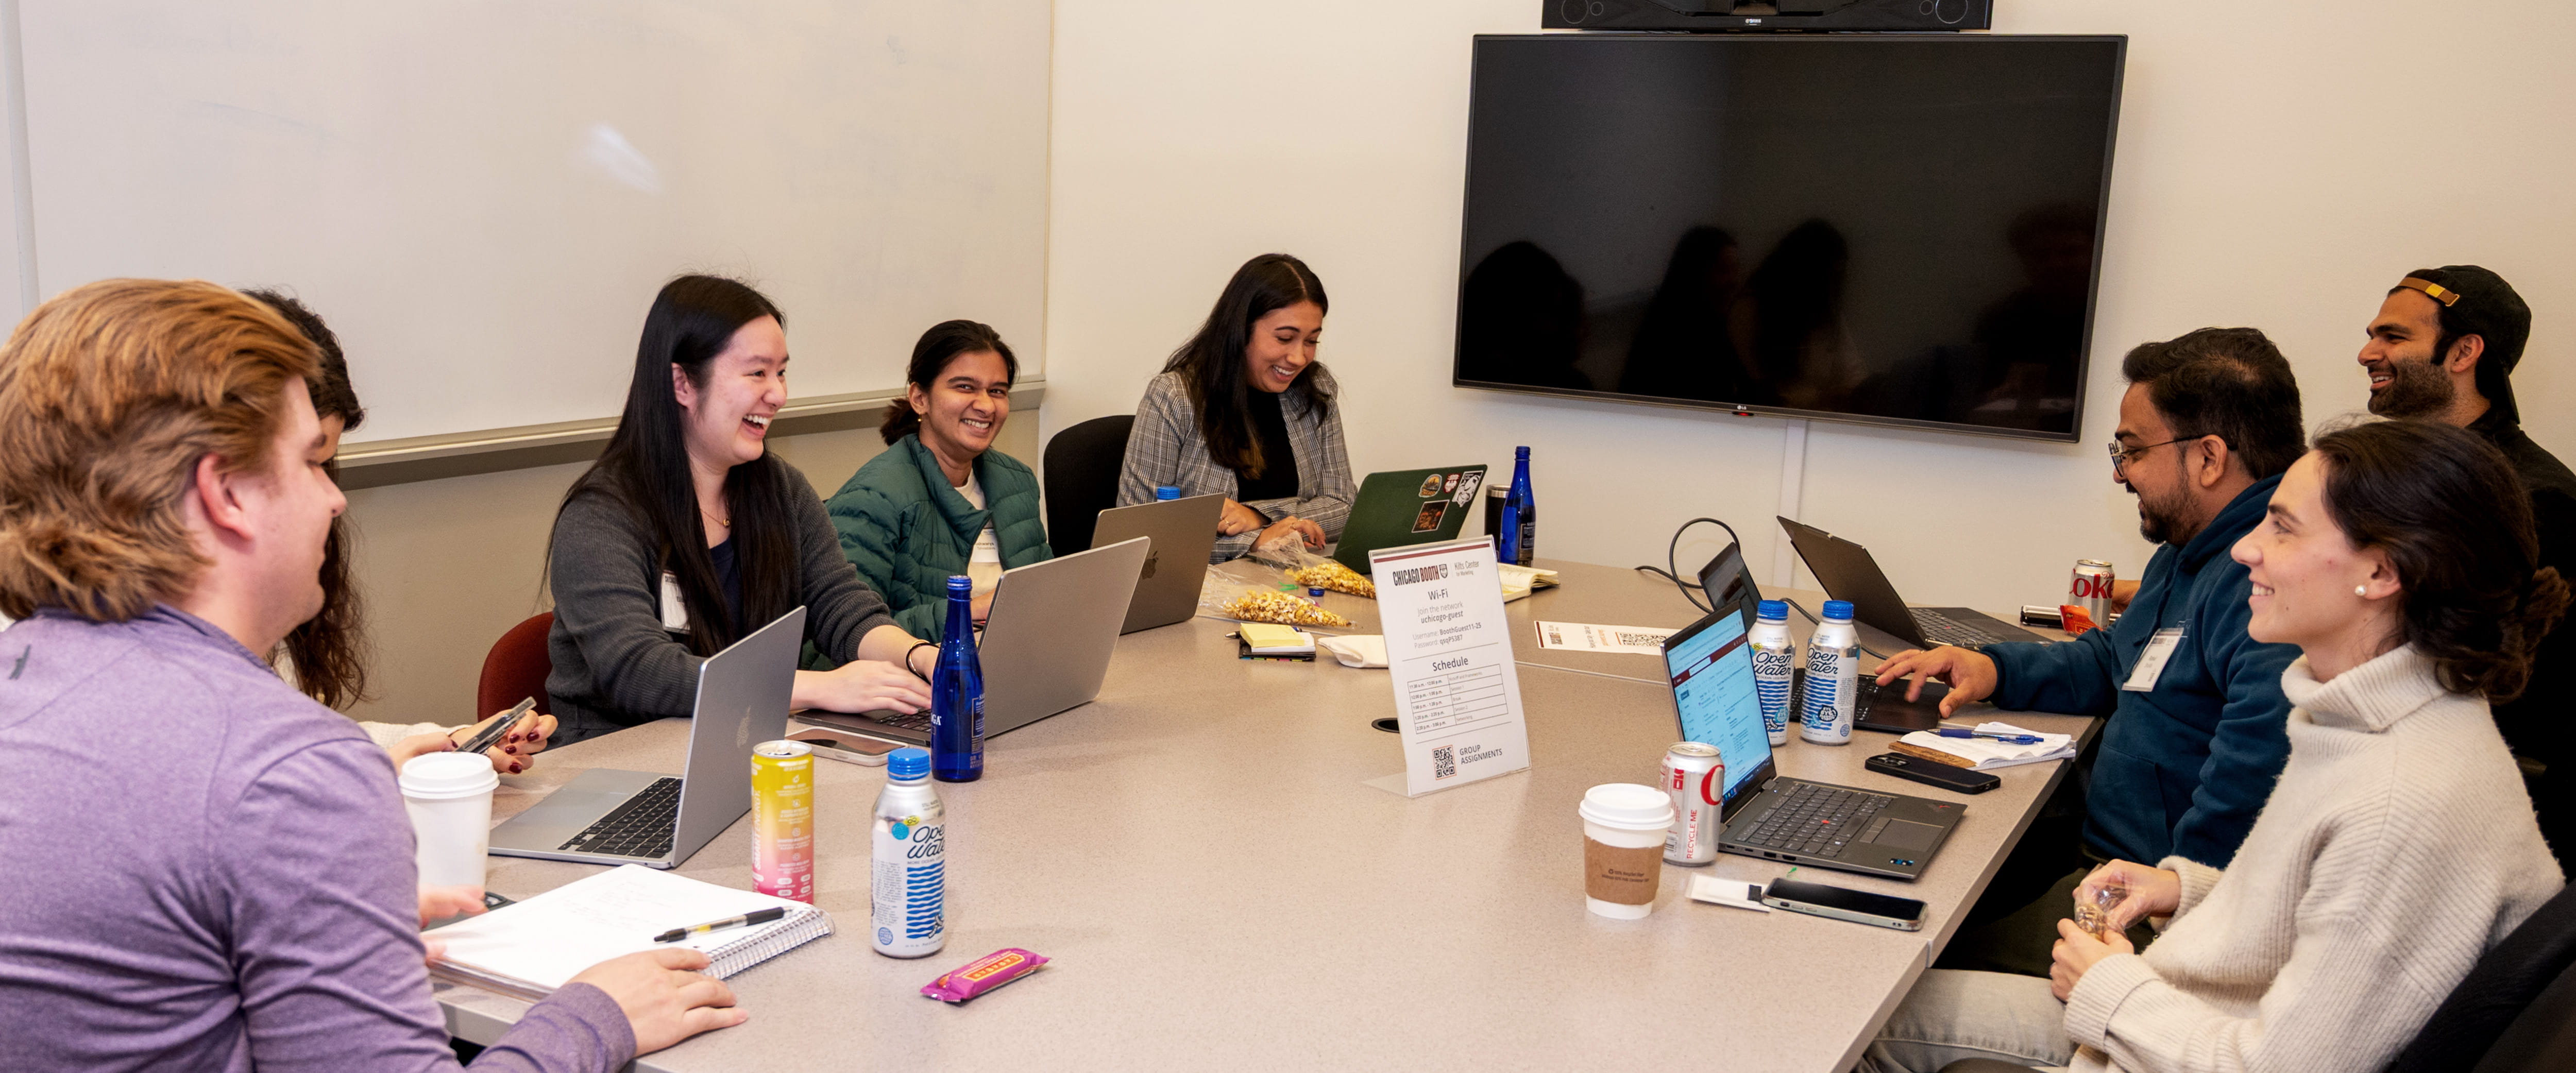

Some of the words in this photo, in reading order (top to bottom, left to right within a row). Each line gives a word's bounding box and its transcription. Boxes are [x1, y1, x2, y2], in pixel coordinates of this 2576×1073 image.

[1465, 560, 1479, 569] Center
[1393, 568, 1420, 586] CHICAGO
[1419, 565, 1439, 582] BOOTH
[1428, 588, 1448, 600] Wi-Fi
[1417, 608, 1429, 617] Join
[1440, 601, 1463, 612] network
[1421, 610, 1463, 623] uchicago-guest
[1412, 631, 1439, 640] Username:
[1439, 622, 1482, 635] BoothGuest11-25
[1414, 640, 1439, 649] Password:
[1756, 652, 1791, 665] Open
[1807, 648, 1838, 662] Open
[1432, 656, 1468, 671] Schedule
[1753, 663, 1791, 675] Water
[1460, 744, 1481, 756] GROUP
[1461, 748, 1502, 765] ASSIGNMENTS
[1690, 809, 1697, 822] ME
[913, 824, 944, 843] Ope
[1686, 824, 1696, 859] RECYCLE
